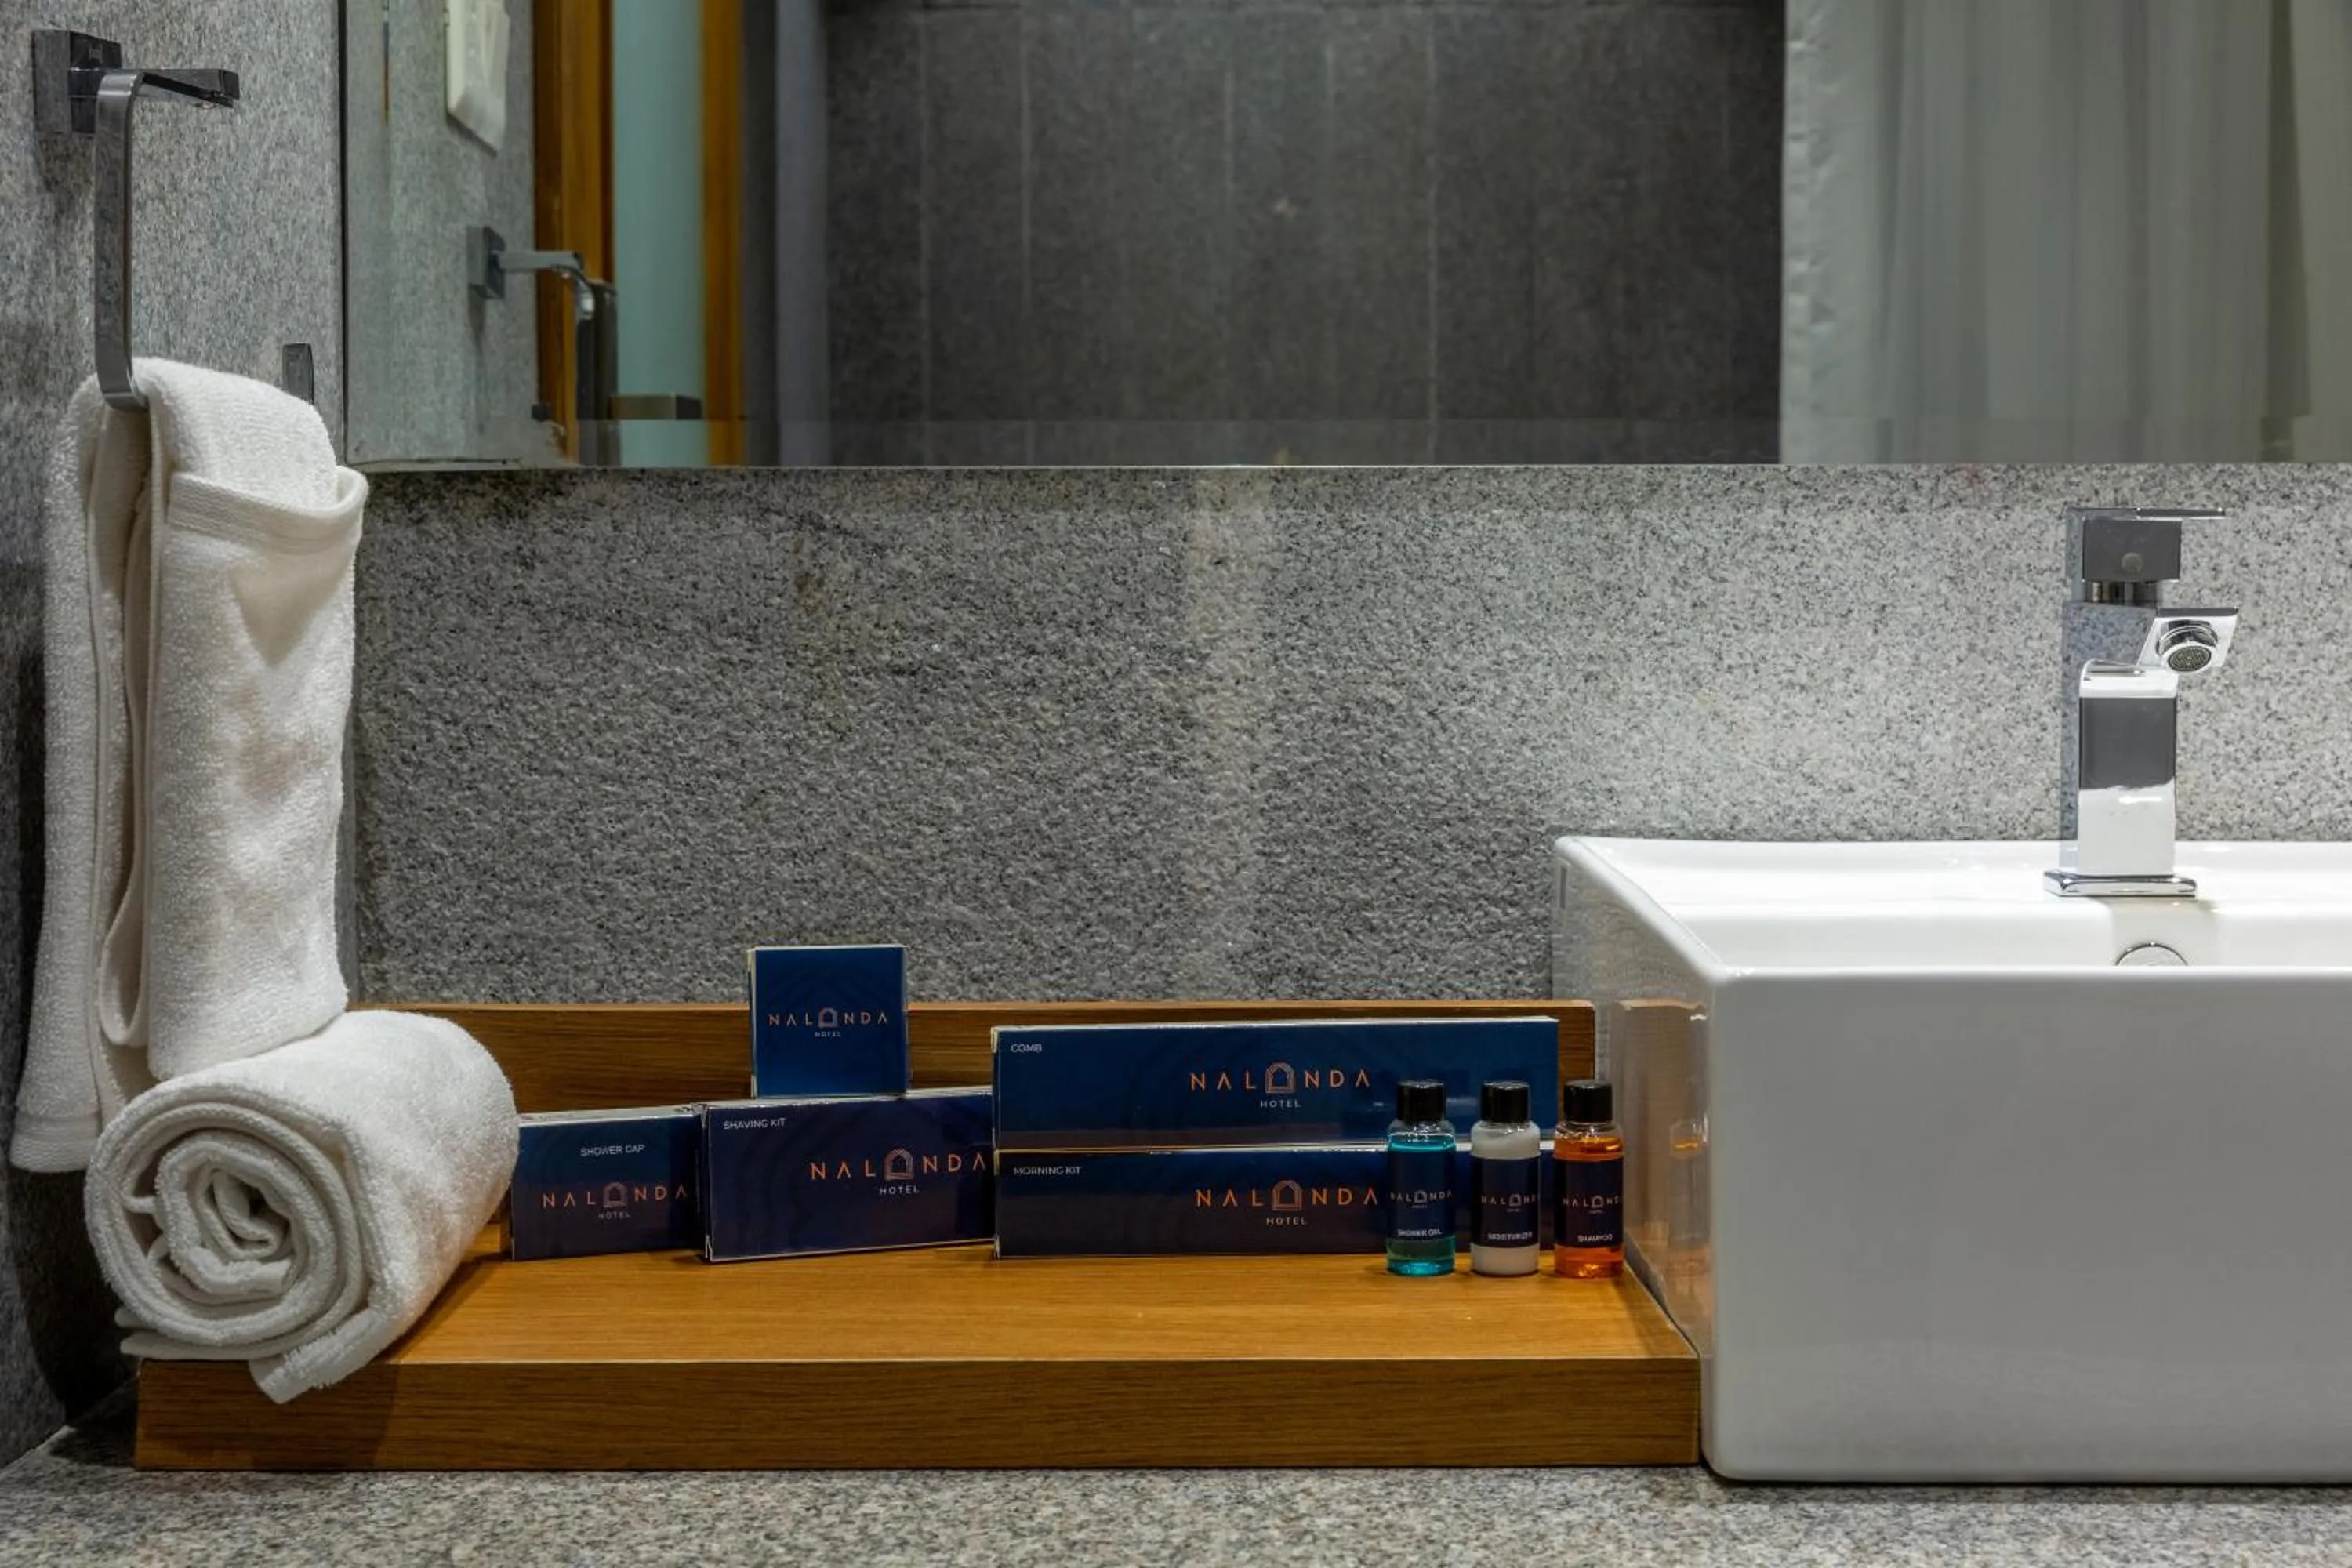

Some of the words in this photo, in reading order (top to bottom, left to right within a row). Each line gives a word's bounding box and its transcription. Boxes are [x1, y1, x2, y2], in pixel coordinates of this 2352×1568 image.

[1011, 1044, 1042, 1053] COMB
[1260, 1100, 1301, 1109] HOTEL
[724, 1119, 768, 1130] SHAVING
[771, 1117, 786, 1127] KIT
[579, 1145, 622, 1157] SHOWER
[625, 1144, 645, 1153] CAP
[1014, 1166, 1064, 1175] MORNING
[1065, 1166, 1081, 1175] KIT
[879, 1185, 919, 1196] HOTEL
[598, 1210, 630, 1219] HOTEL
[1266, 1217, 1308, 1225] HOTEL
